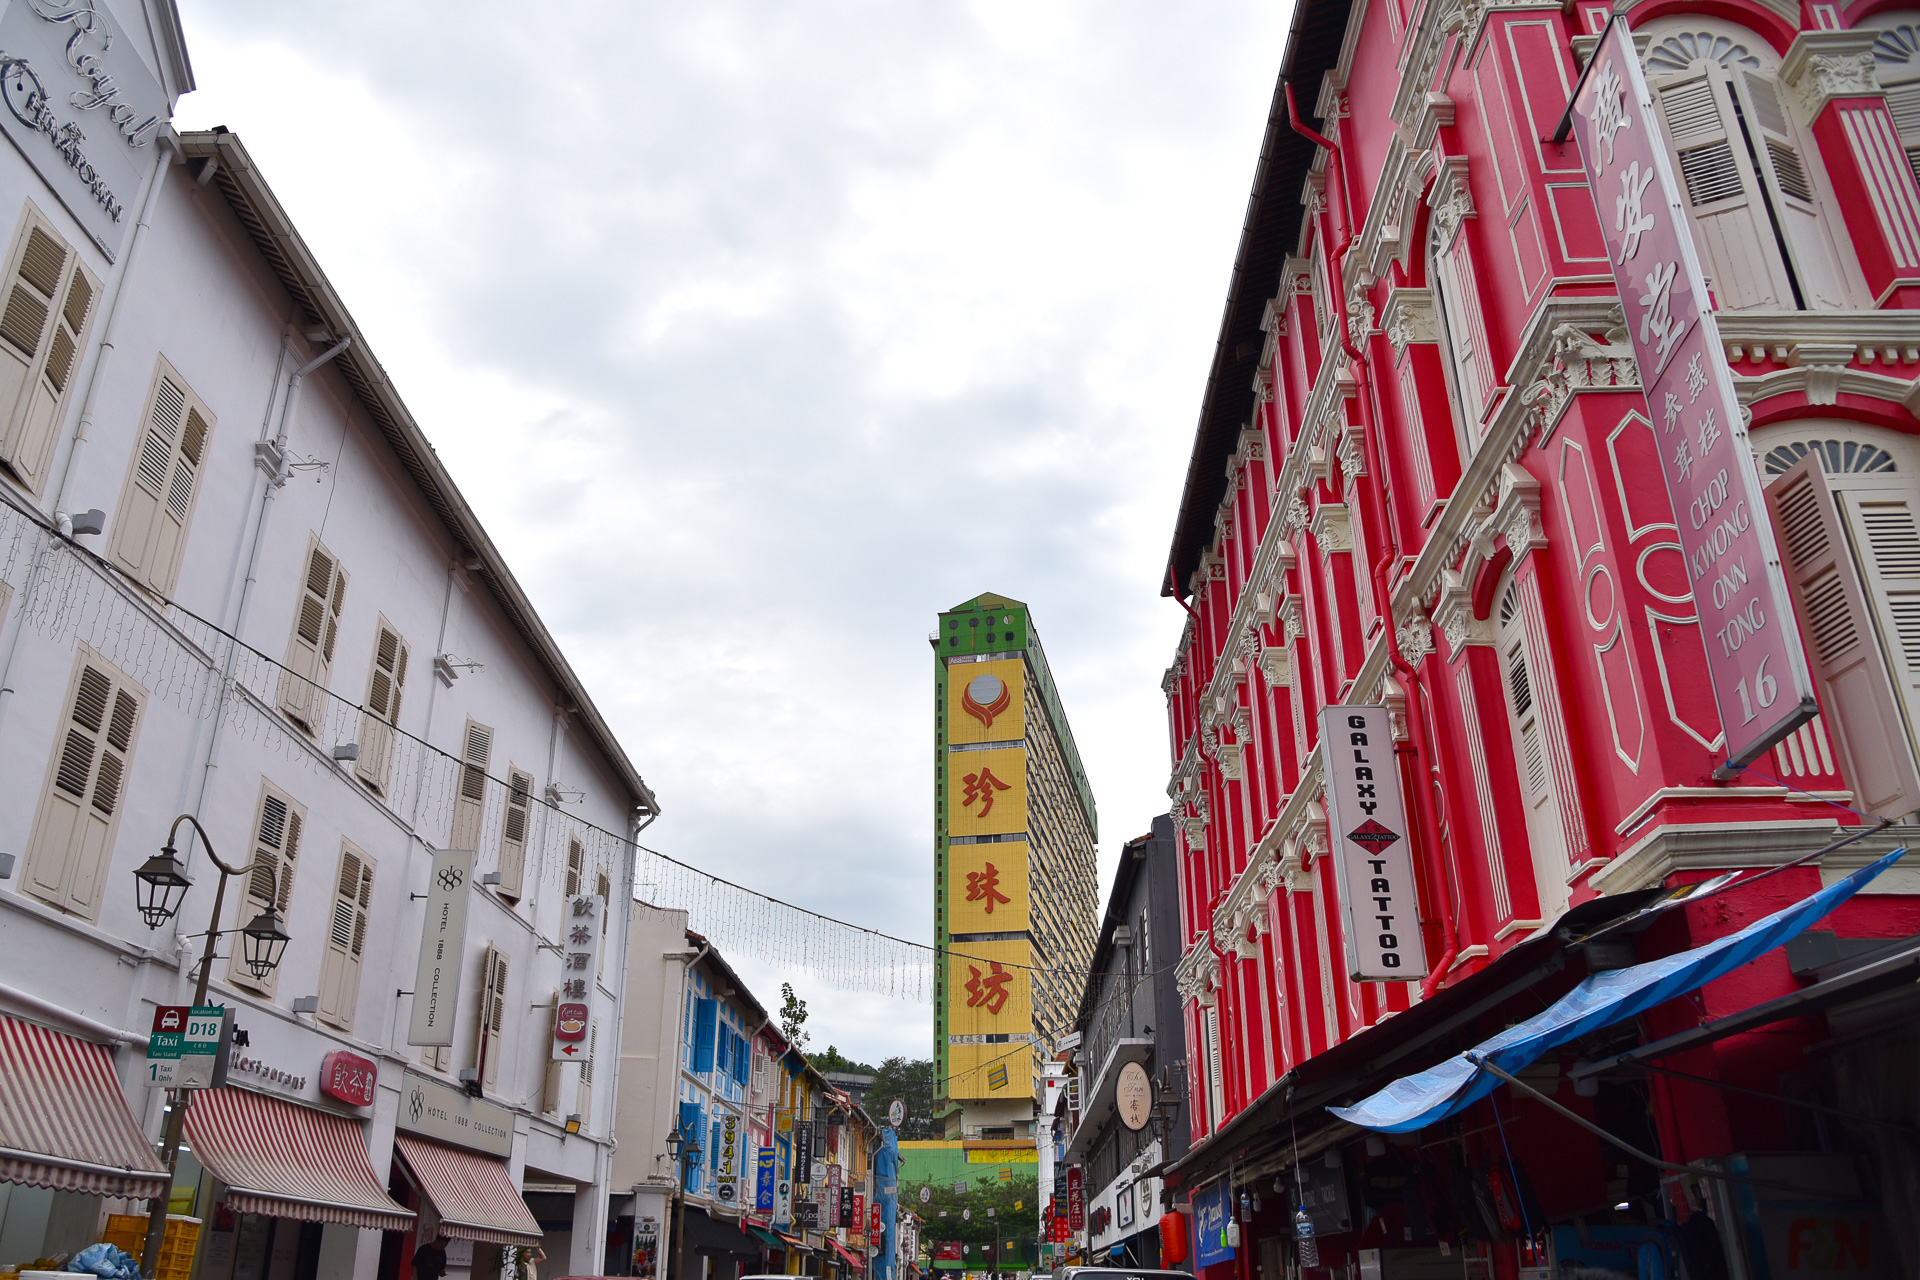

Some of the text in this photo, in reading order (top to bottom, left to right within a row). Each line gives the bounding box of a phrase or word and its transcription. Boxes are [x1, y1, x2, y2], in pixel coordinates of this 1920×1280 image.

[1689, 468, 1730, 532] CHOP
[1691, 500, 1751, 583] KWONG
[1712, 556, 1749, 611] ONN
[1716, 595, 1766, 659] TONG
[1733, 652, 1779, 728] 16
[1347, 715, 1378, 816] GALAXY
[962, 766, 1013, 1016] 珍珠坊
[1367, 859, 1401, 969] TATTOO
[427, 902, 450, 1027] HOTEL 1888 COLLECTION
[562, 896, 595, 999] 飲茶酒樓
[157, 1035, 179, 1047] Taxi
[189, 1022, 217, 1036] D18
[149, 1063, 158, 1081] 1
[230, 1050, 306, 1090] Restaurant
[333, 1062, 364, 1096] 飲茶
[1123, 1082, 1144, 1093] Inn
[1124, 1070, 1143, 1080] The
[428, 1106, 507, 1138] HOTEL 1888 COLLECTION
[723, 1115, 736, 1175] 3941
[717, 1175, 738, 1184] CAFE
[1787, 1217, 1871, 1272] F&N
